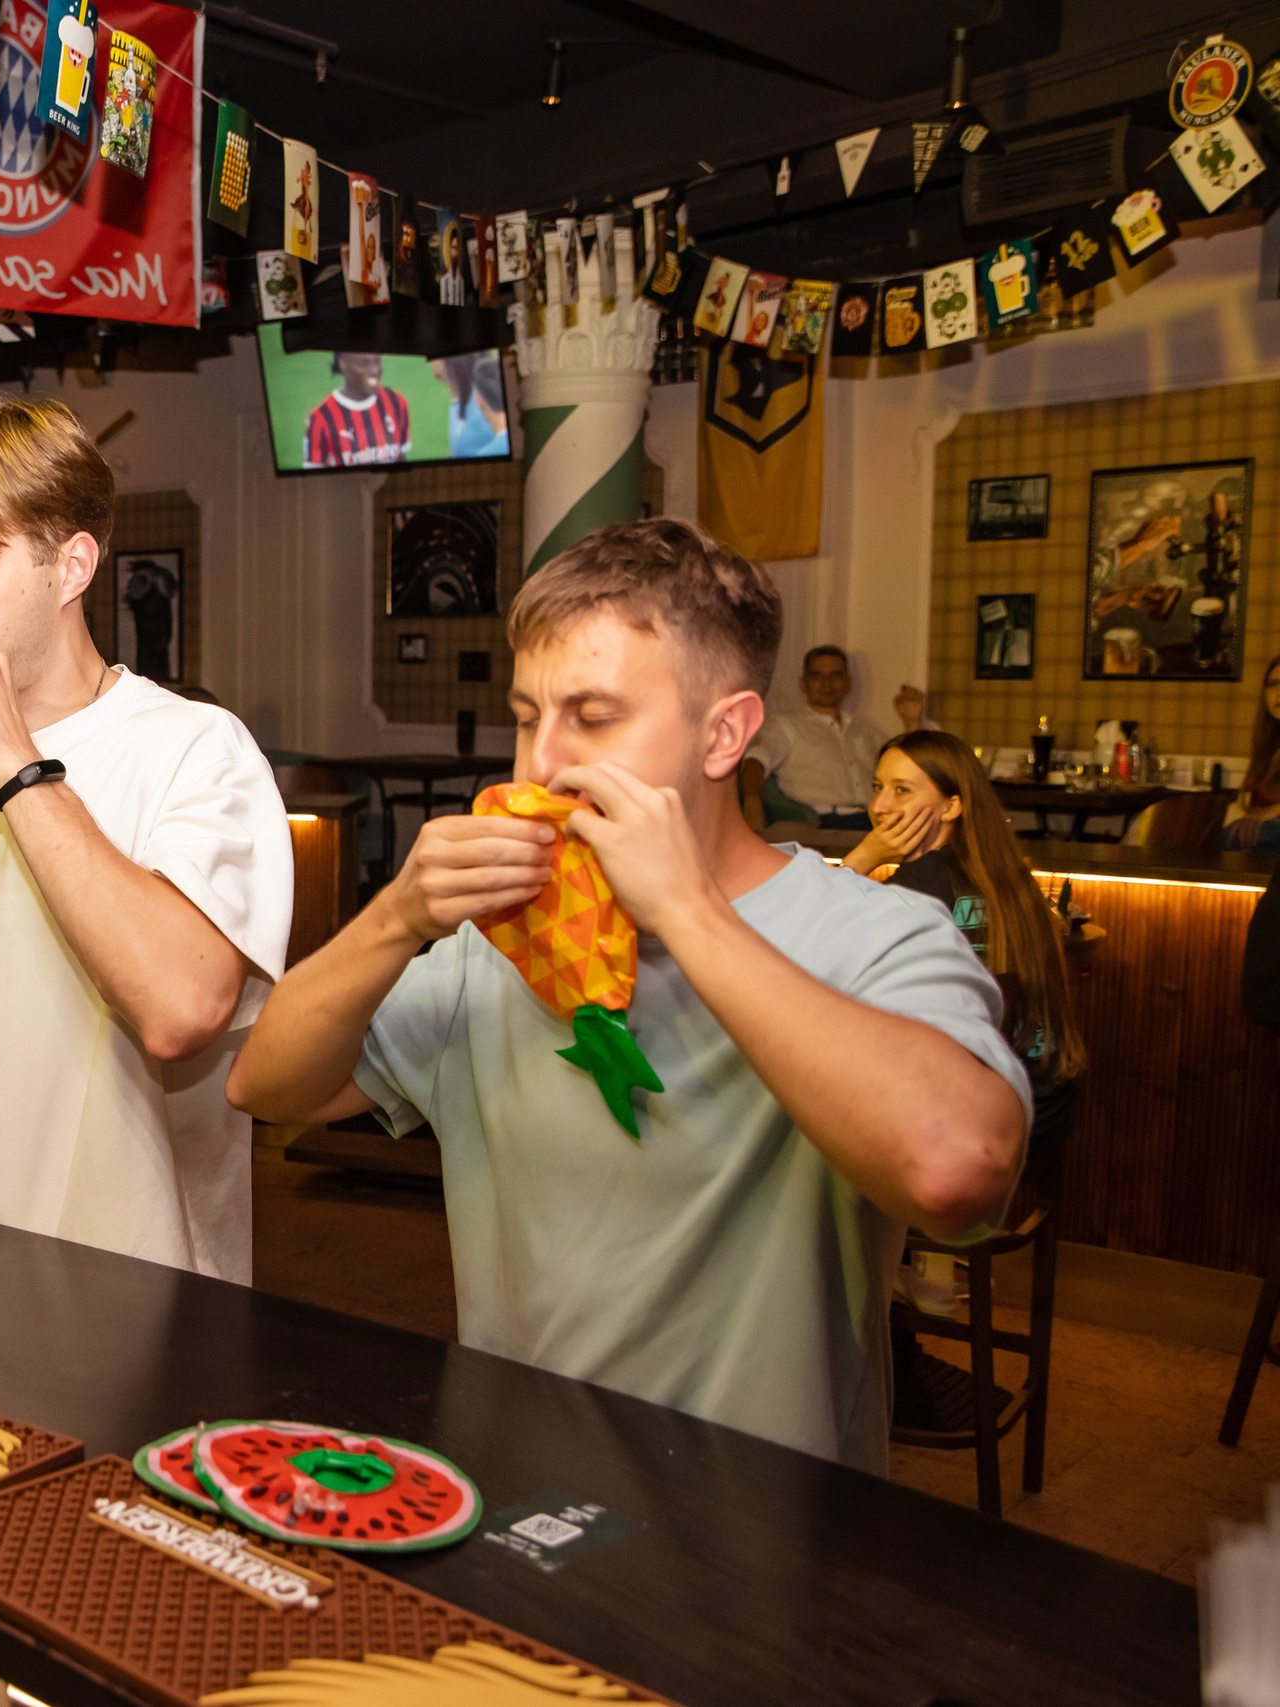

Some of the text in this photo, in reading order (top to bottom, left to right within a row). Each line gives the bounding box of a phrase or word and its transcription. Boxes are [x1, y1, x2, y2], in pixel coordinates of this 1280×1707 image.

[1177, 46, 1246, 83] PAULANER
[48, 108, 81, 136] BEER KING
[104, 1500, 309, 1603] GRIMBERGEN
